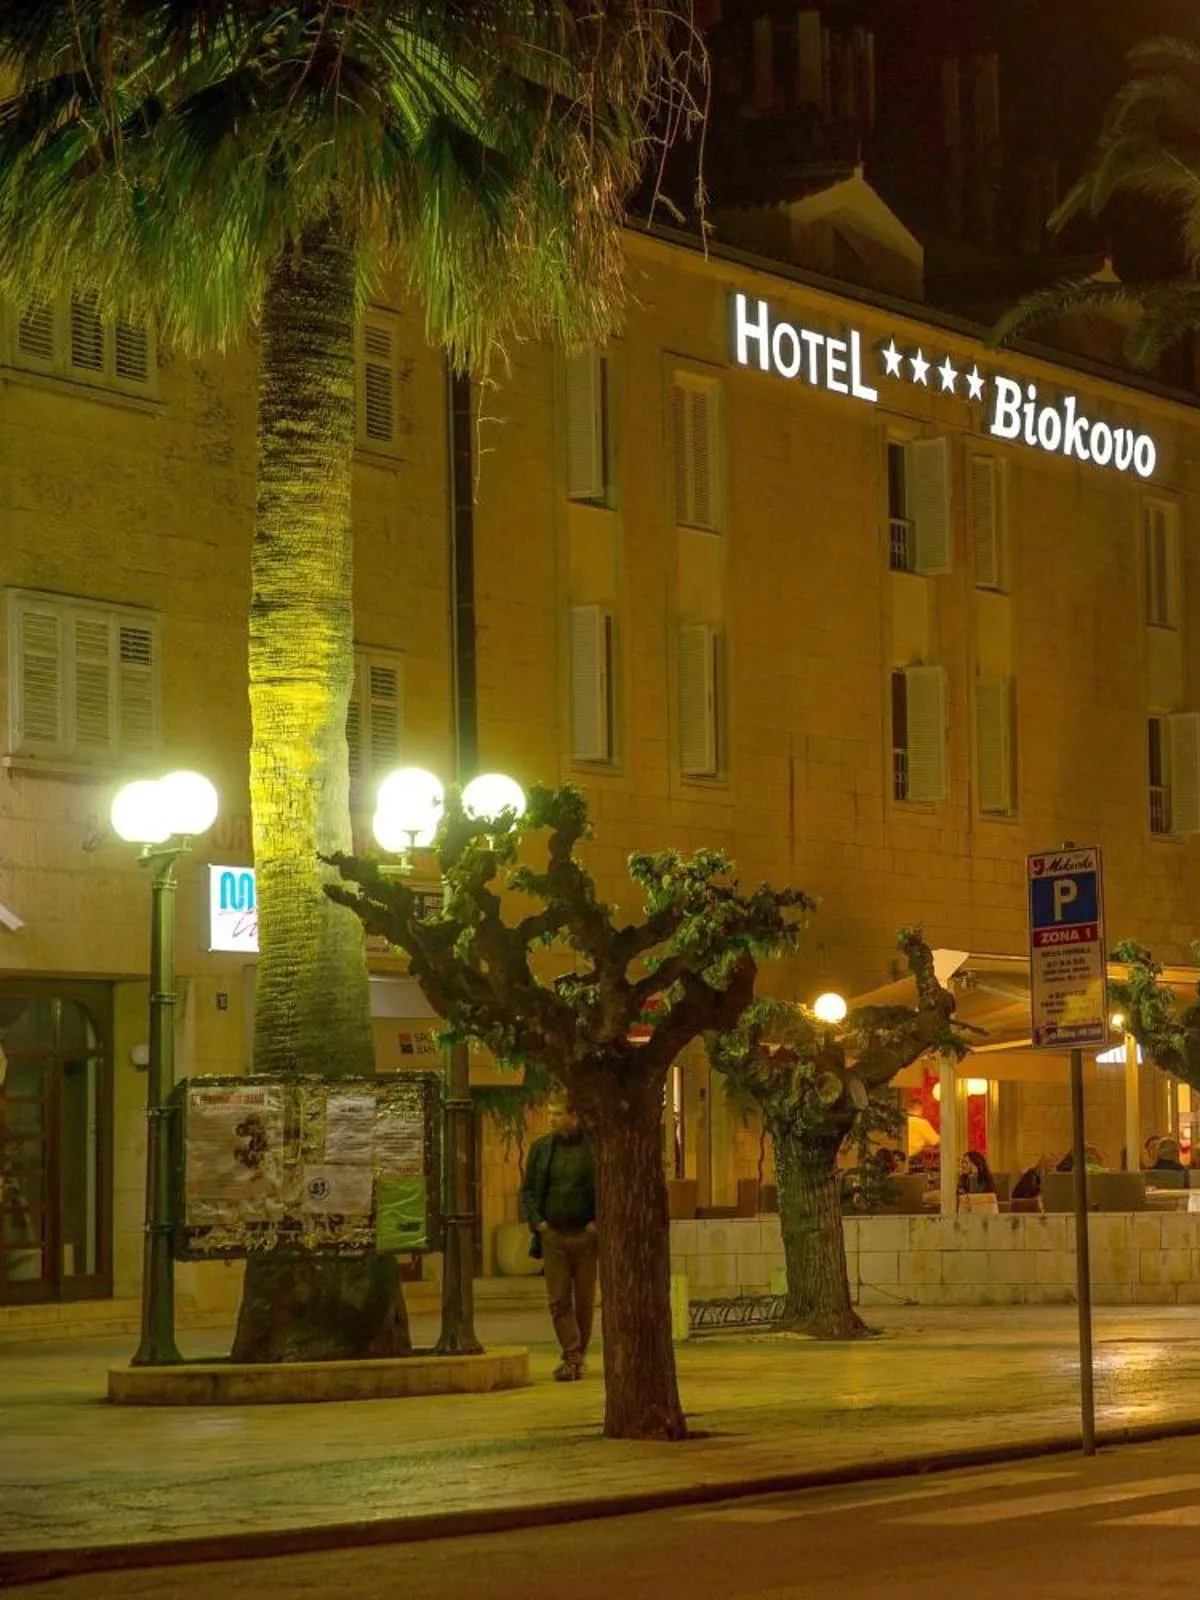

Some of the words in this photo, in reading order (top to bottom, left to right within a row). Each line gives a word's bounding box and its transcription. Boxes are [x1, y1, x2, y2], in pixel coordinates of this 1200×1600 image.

[735, 293, 878, 402] HOTEL
[990, 375, 1157, 478] Biokovo
[1054, 879, 1077, 921] P
[1041, 930, 1080, 945] ZONA
[1085, 928, 1092, 939] 1
